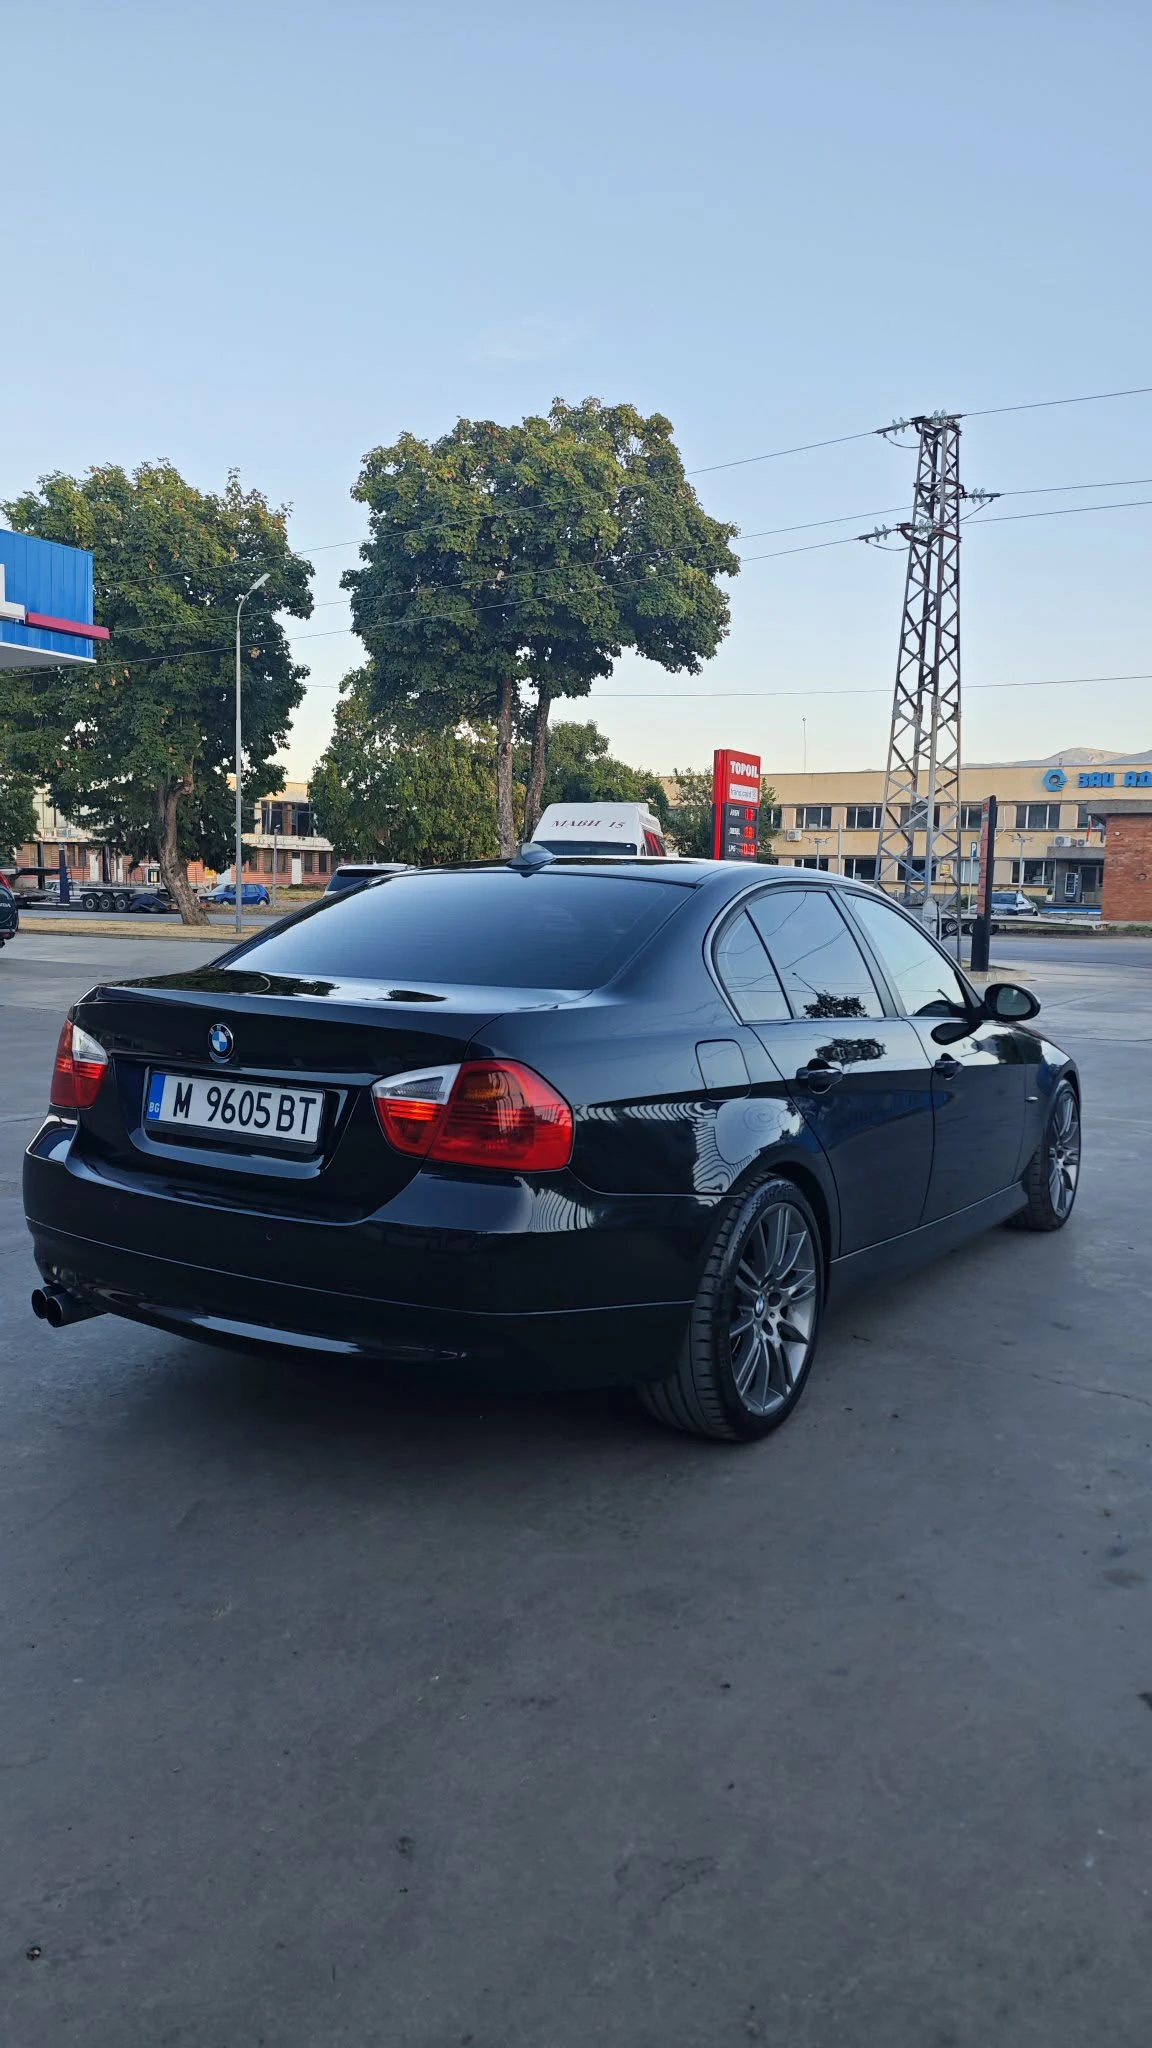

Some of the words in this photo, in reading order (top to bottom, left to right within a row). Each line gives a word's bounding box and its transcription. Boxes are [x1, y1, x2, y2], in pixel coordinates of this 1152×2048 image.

[730, 761, 759, 778] TOPOIL
[609, 821, 625, 829] 15
[971, 843, 976, 856] P
[173, 1082, 193, 1119] M
[149, 1102, 160, 1113] BG
